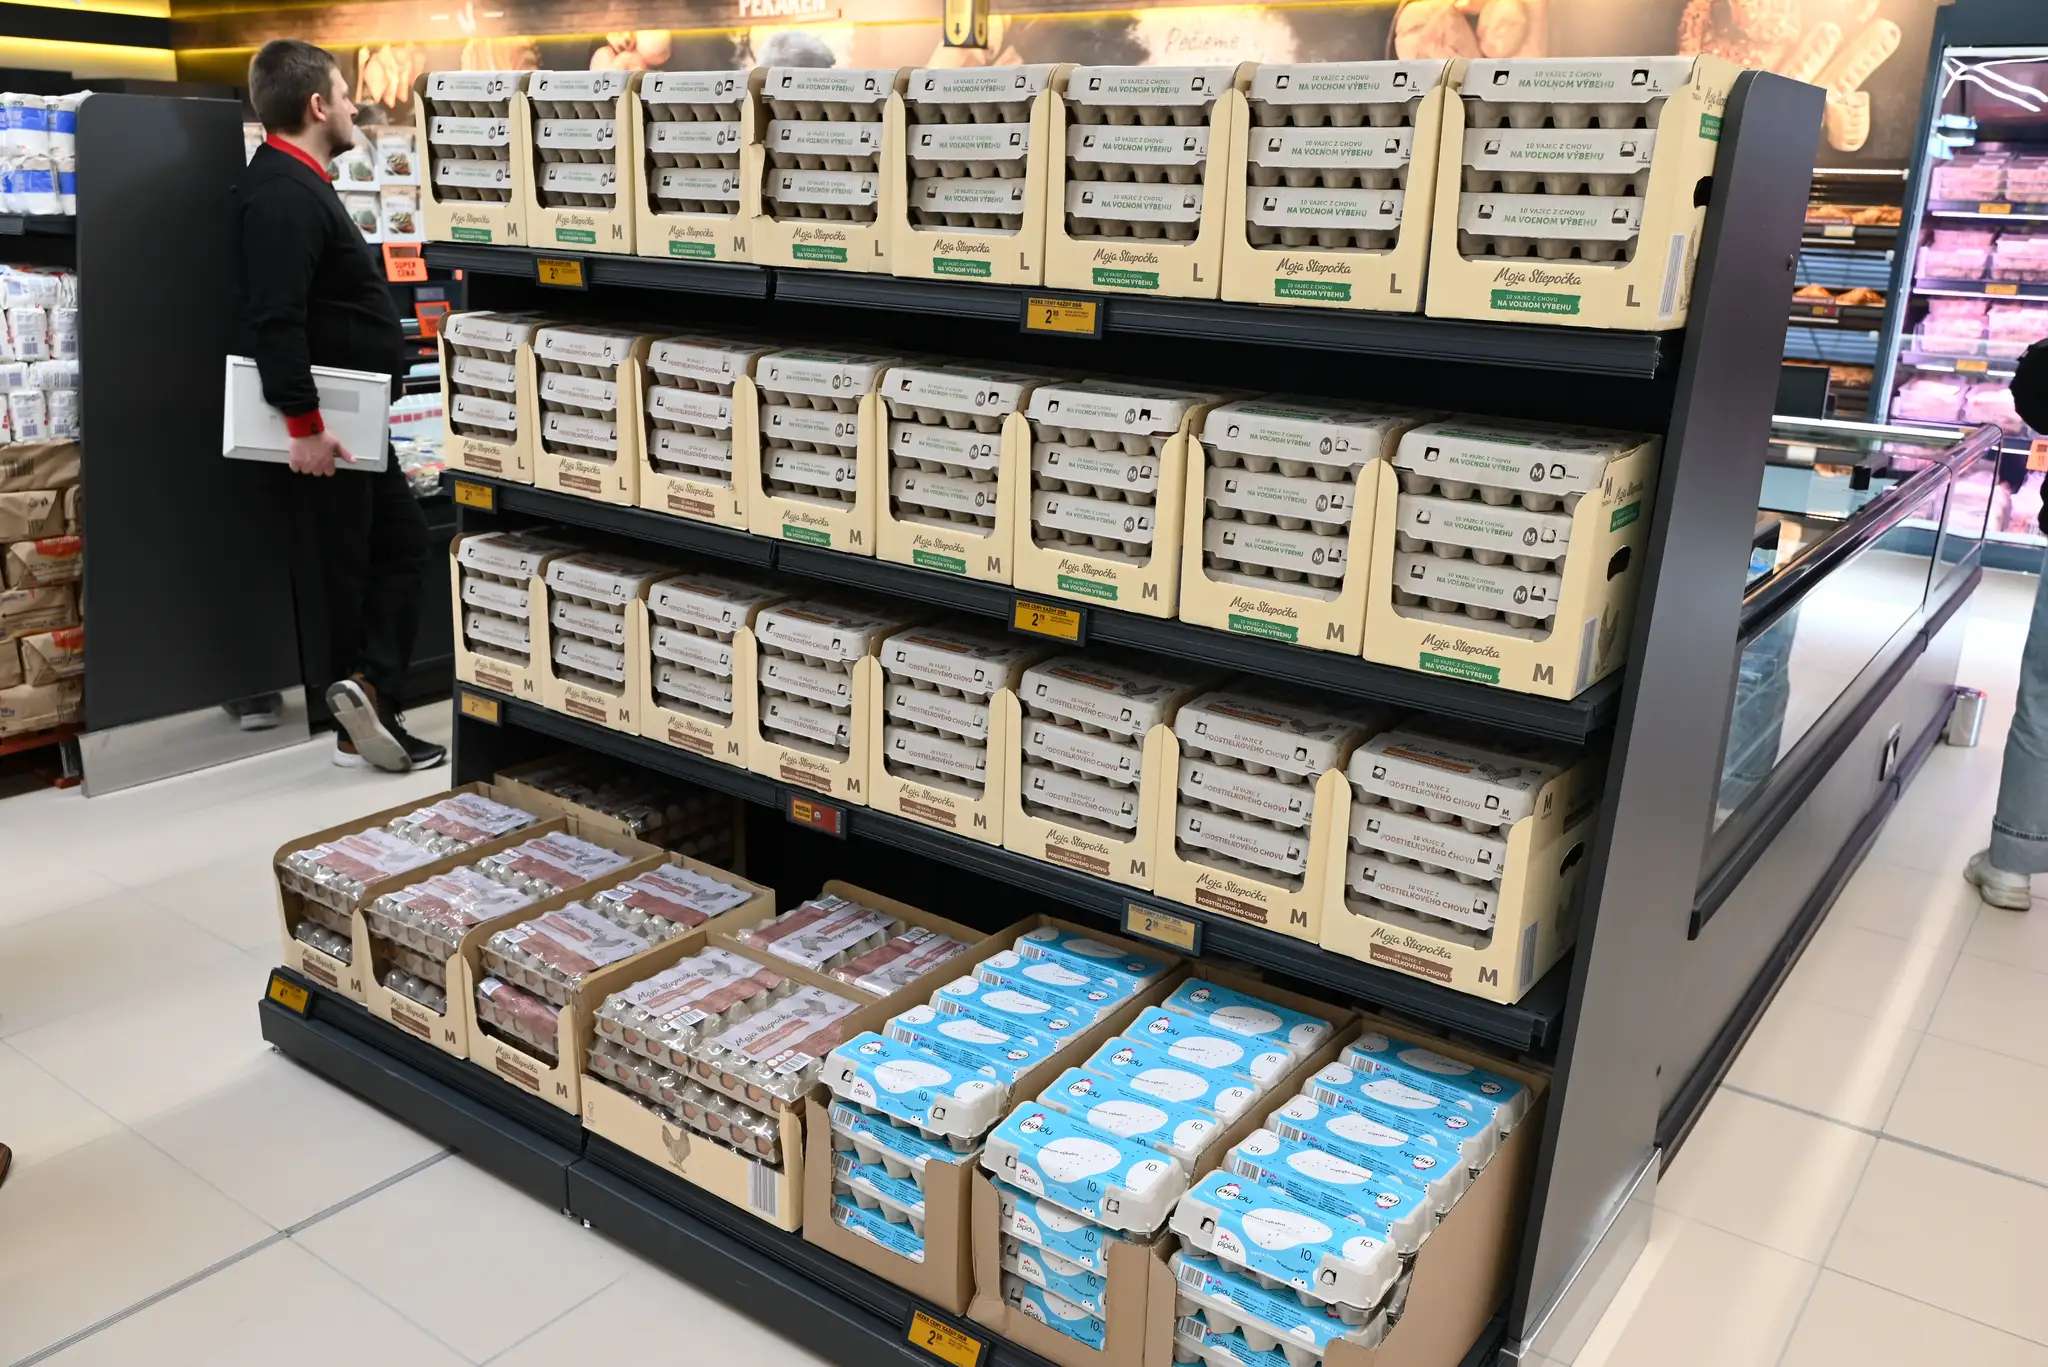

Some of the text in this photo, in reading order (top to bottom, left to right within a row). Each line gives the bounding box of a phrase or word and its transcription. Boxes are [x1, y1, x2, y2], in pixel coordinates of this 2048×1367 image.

[1576, 79, 1614, 88] VÝBEHU
[1653, 80, 1658, 88] L
[1567, 150, 1604, 160] VÝBEHU
[1560, 216, 1597, 226] VÝBEHU
[508, 223, 517, 237] M
[612, 225, 622, 239] M
[793, 227, 812, 241] Moja
[734, 237, 746, 252] M
[875, 240, 883, 256] L
[933, 239, 990, 254] Moja Sliepočka
[1020, 252, 1029, 270] L
[1093, 248, 1158, 264] Moja Sliepočka
[1193, 263, 1203, 282] L
[1276, 258, 1351, 275] Moja Sliepočka
[1390, 273, 1402, 293] L
[1493, 268, 1582, 286] Moja Sliepočka
[1319, 290, 1344, 298] VÝBEHU
[1626, 285, 1640, 307] L
[1542, 301, 1571, 310] VÝBEHU
[518, 457, 525, 469] L
[1492, 463, 1520, 473] VÝBEHU
[619, 477, 626, 490] L
[734, 501, 742, 514] L
[850, 529, 862, 545] M
[913, 534, 932, 550] Moja
[988, 556, 1001, 573] M
[1058, 559, 1080, 576] Moja
[1142, 582, 1158, 600] M
[1230, 596, 1298, 619] Moja Sliepočka
[1326, 623, 1345, 642] M
[1421, 634, 1500, 658] Moja Sliepočka
[1466, 670, 1492, 680] VÝBEHU
[1533, 664, 1554, 685] M
[524, 679, 533, 692] M
[619, 709, 630, 722] M
[728, 741, 739, 755] M
[847, 778, 860, 793] M
[900, 784, 920, 799] Moja
[1453, 798, 1480, 810] CHOVU
[1502, 808, 1509, 816] M
[973, 813, 987, 829] M
[1046, 829, 1109, 854] Moja Sliepočka
[1130, 860, 1146, 877] M
[1196, 872, 1267, 902] Moja Sliepočka
[1245, 911, 1264, 921] CHOVU
[1290, 908, 1307, 927] M
[1371, 928, 1452, 959] Moja Sliepočka
[1373, 953, 1448, 979] PODSTIELKOVÉHO CHOVU
[1478, 966, 1498, 986] M
[350, 980, 362, 992] M
[637, 987, 660, 1001] Moja
[1193, 990, 1221, 1005] pipidu
[1149, 1019, 1180, 1036] pipidu
[444, 1030, 456, 1044] M
[735, 1031, 757, 1046] Moja
[862, 1044, 891, 1058] pipidu
[1112, 1051, 1143, 1067] pipidu
[556, 1082, 568, 1098] M
[854, 1088, 872, 1099] pipidu
[918, 1091, 928, 1100] 10
[1072, 1082, 1101, 1099] pipidu
[1022, 1119, 1053, 1136] pipidu
[1145, 1163, 1157, 1171] 10
[1020, 1174, 1037, 1185] pipidu
[1087, 1180, 1096, 1193] 10
[1219, 1188, 1253, 1205] pipidu
[1017, 1220, 1035, 1235] pipidu
[1085, 1230, 1094, 1242] 10
[1217, 1240, 1239, 1253] pipidu
[1300, 1249, 1312, 1261] 10
[1022, 1260, 1040, 1277] pipidu
[1087, 1275, 1097, 1287] 10
[1212, 1284, 1231, 1297] pipidu
